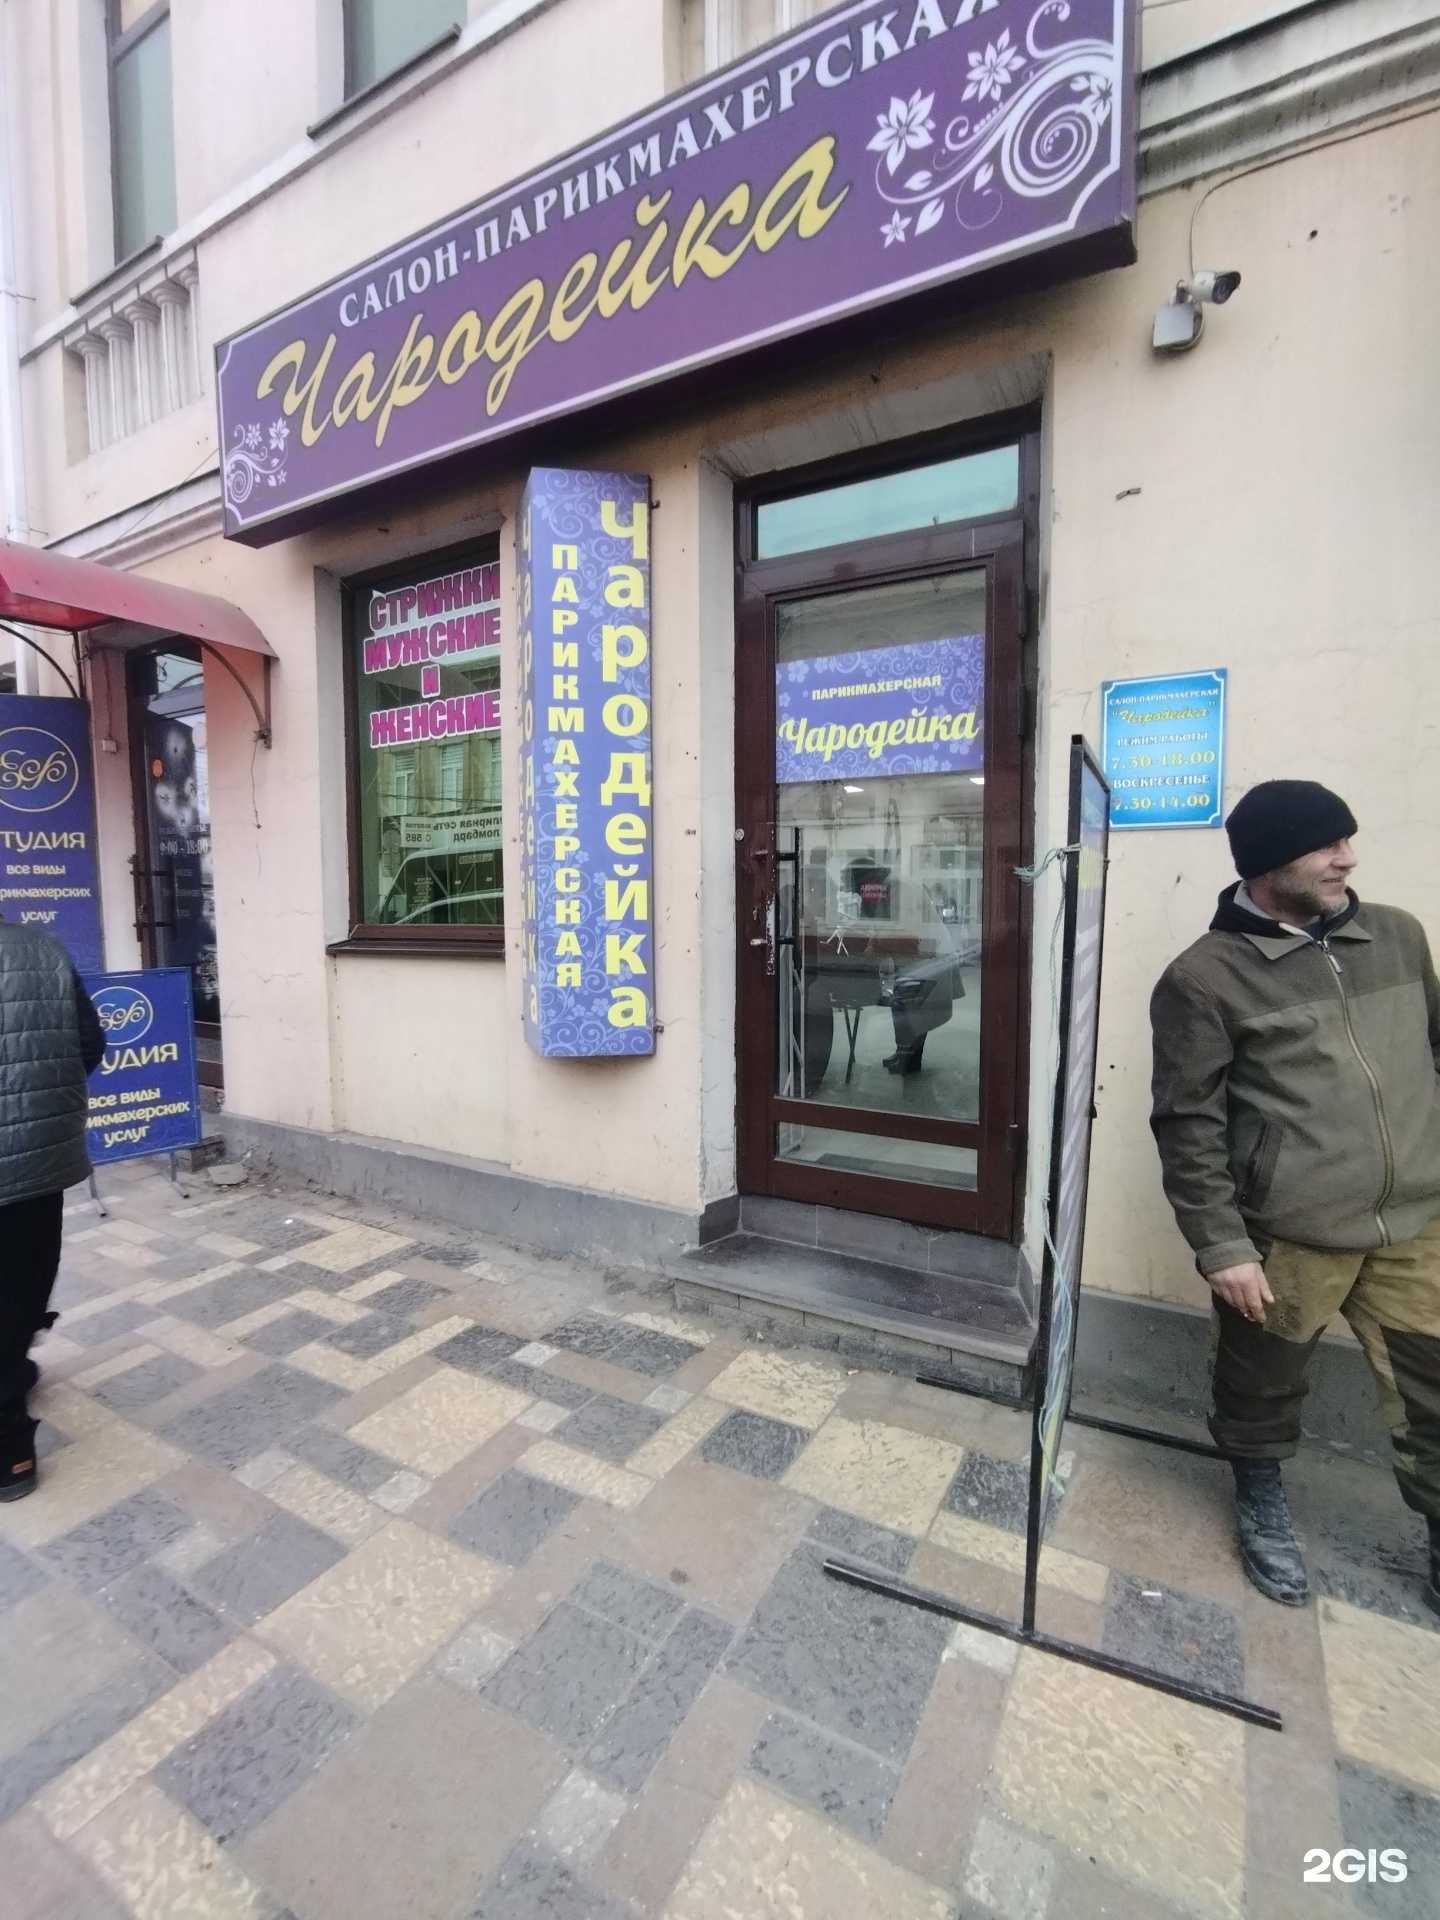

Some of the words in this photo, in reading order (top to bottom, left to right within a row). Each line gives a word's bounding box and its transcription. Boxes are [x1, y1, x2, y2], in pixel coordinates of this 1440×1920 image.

[256, 135, 853, 449] Чародейка
[370, 561, 500, 631] СТРИЖКИ
[364, 608, 500, 674] МУЖСКИЕ
[421, 664, 440, 698] И
[370, 690, 500, 749] ЖЕНСКИЕ
[779, 706, 980, 762] Чародейка
[548, 543, 585, 988] ПАРИКМАХЕРСКАЯ
[1113, 775, 1210, 789] ВОСКРЕСЕНЬЕ
[0, 831, 86, 853] ТУДИЯ
[6, 864, 31, 875] все
[33, 864, 67, 875] виды
[0, 887, 91, 900] рикмахерских
[21, 911, 58, 924] услуг
[101, 1043, 178, 1075] УДИЯ
[88, 1094, 118, 1109] все
[120, 1088, 161, 1104] виды
[85, 1101, 190, 1128] икмахерских
[104, 1126, 150, 1148] услуг
